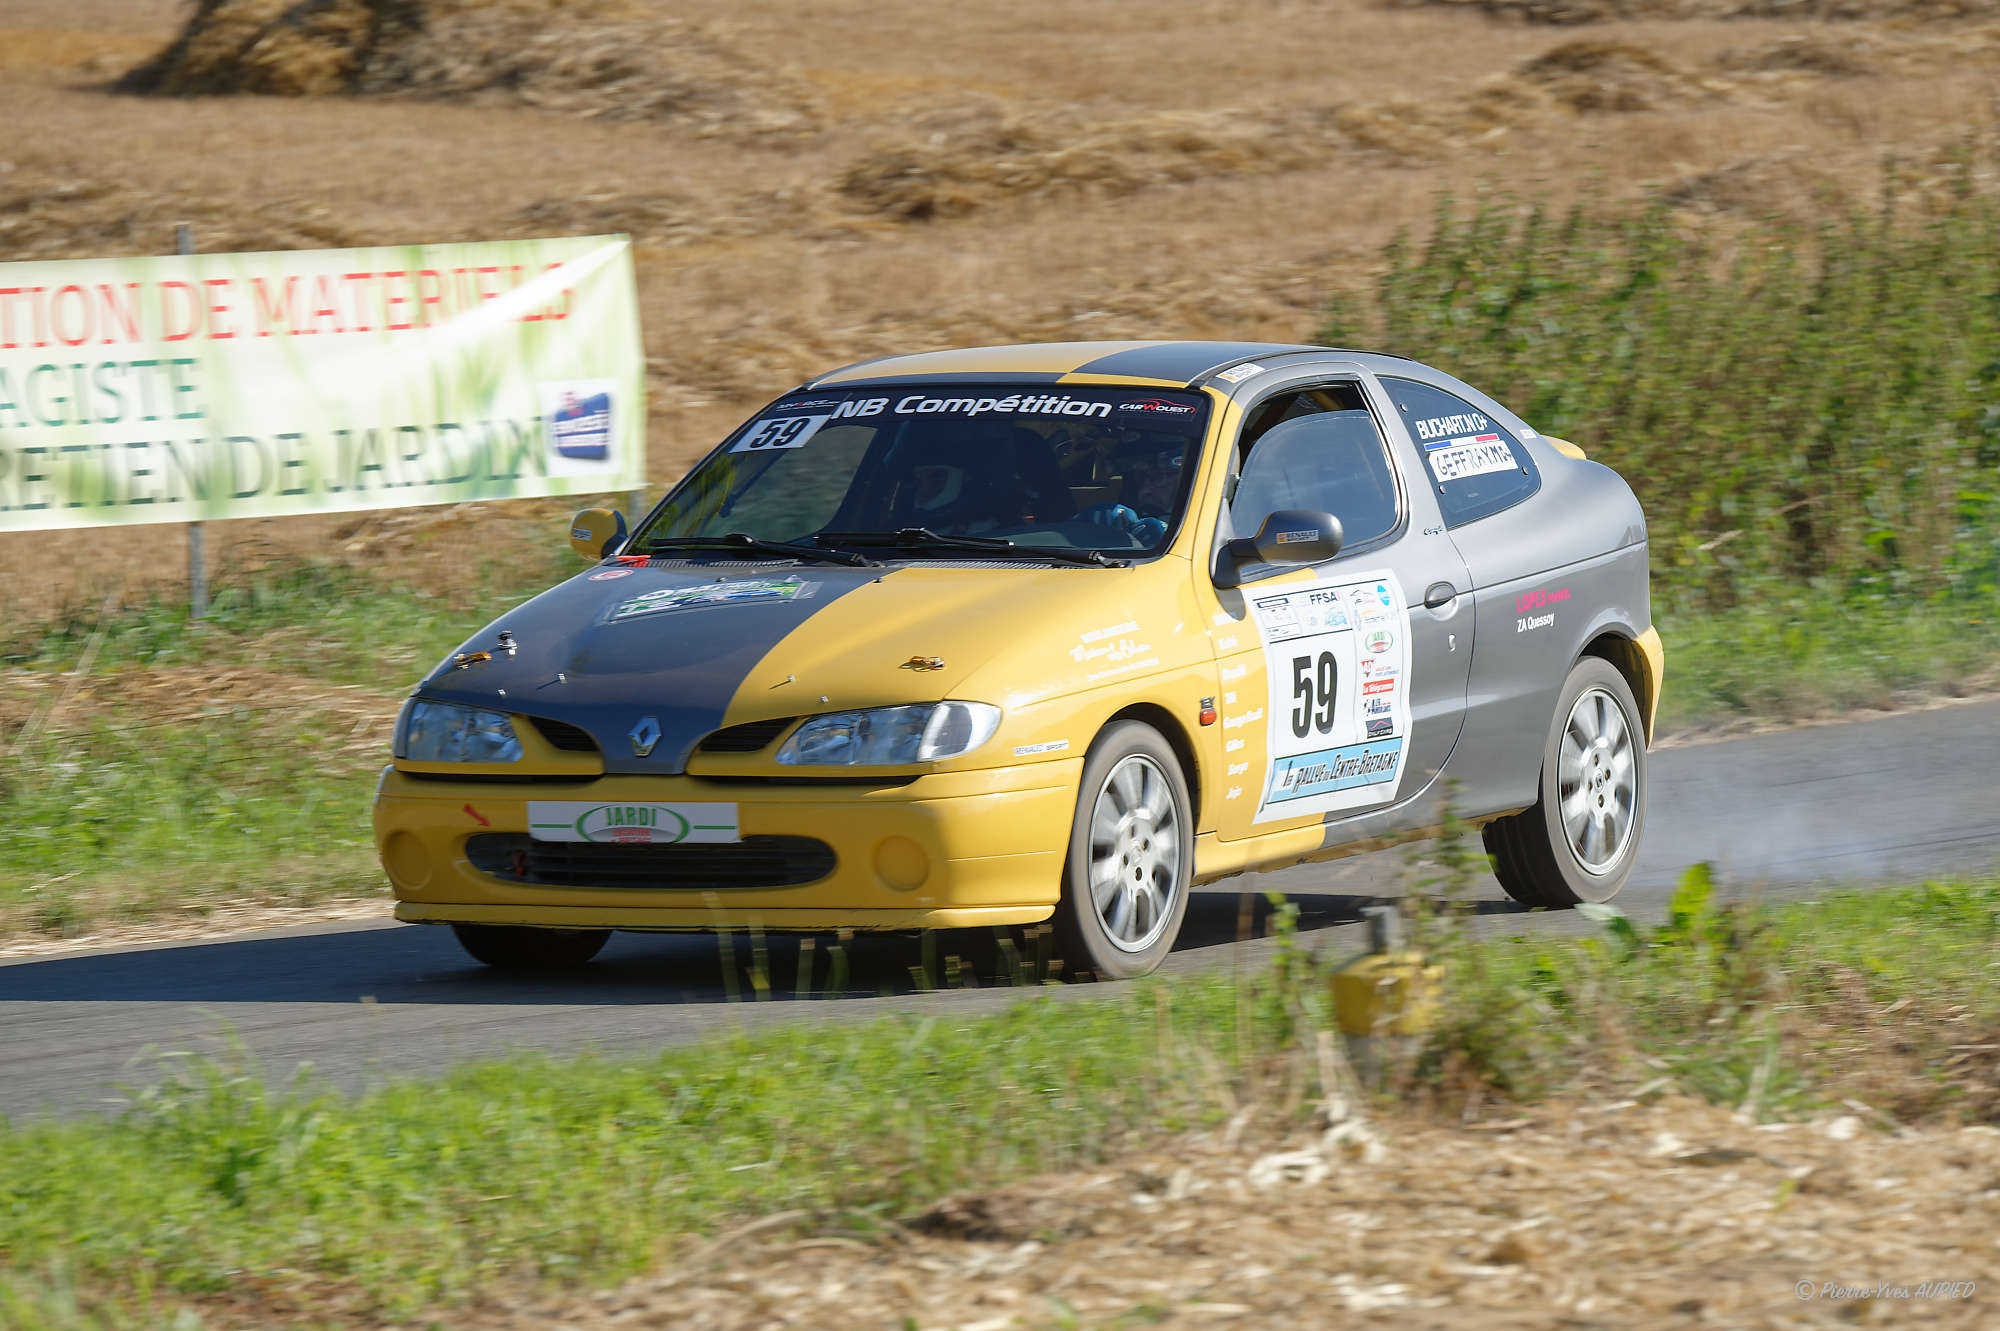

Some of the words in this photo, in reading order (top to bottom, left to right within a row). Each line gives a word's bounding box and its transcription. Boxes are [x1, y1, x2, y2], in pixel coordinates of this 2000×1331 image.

[157, 278, 238, 341] DE
[831, 397, 890, 420] NB
[894, 394, 1113, 418] Compétition
[750, 417, 811, 448] 59
[224, 432, 308, 499] DE
[324, 415, 548, 494] JARDIN
[1310, 591, 1337, 605] FFSA
[1516, 587, 1546, 614] LOPES
[1517, 618, 1527, 633] ZA
[1292, 651, 1338, 739] 59
[606, 807, 657, 826] JARDI
